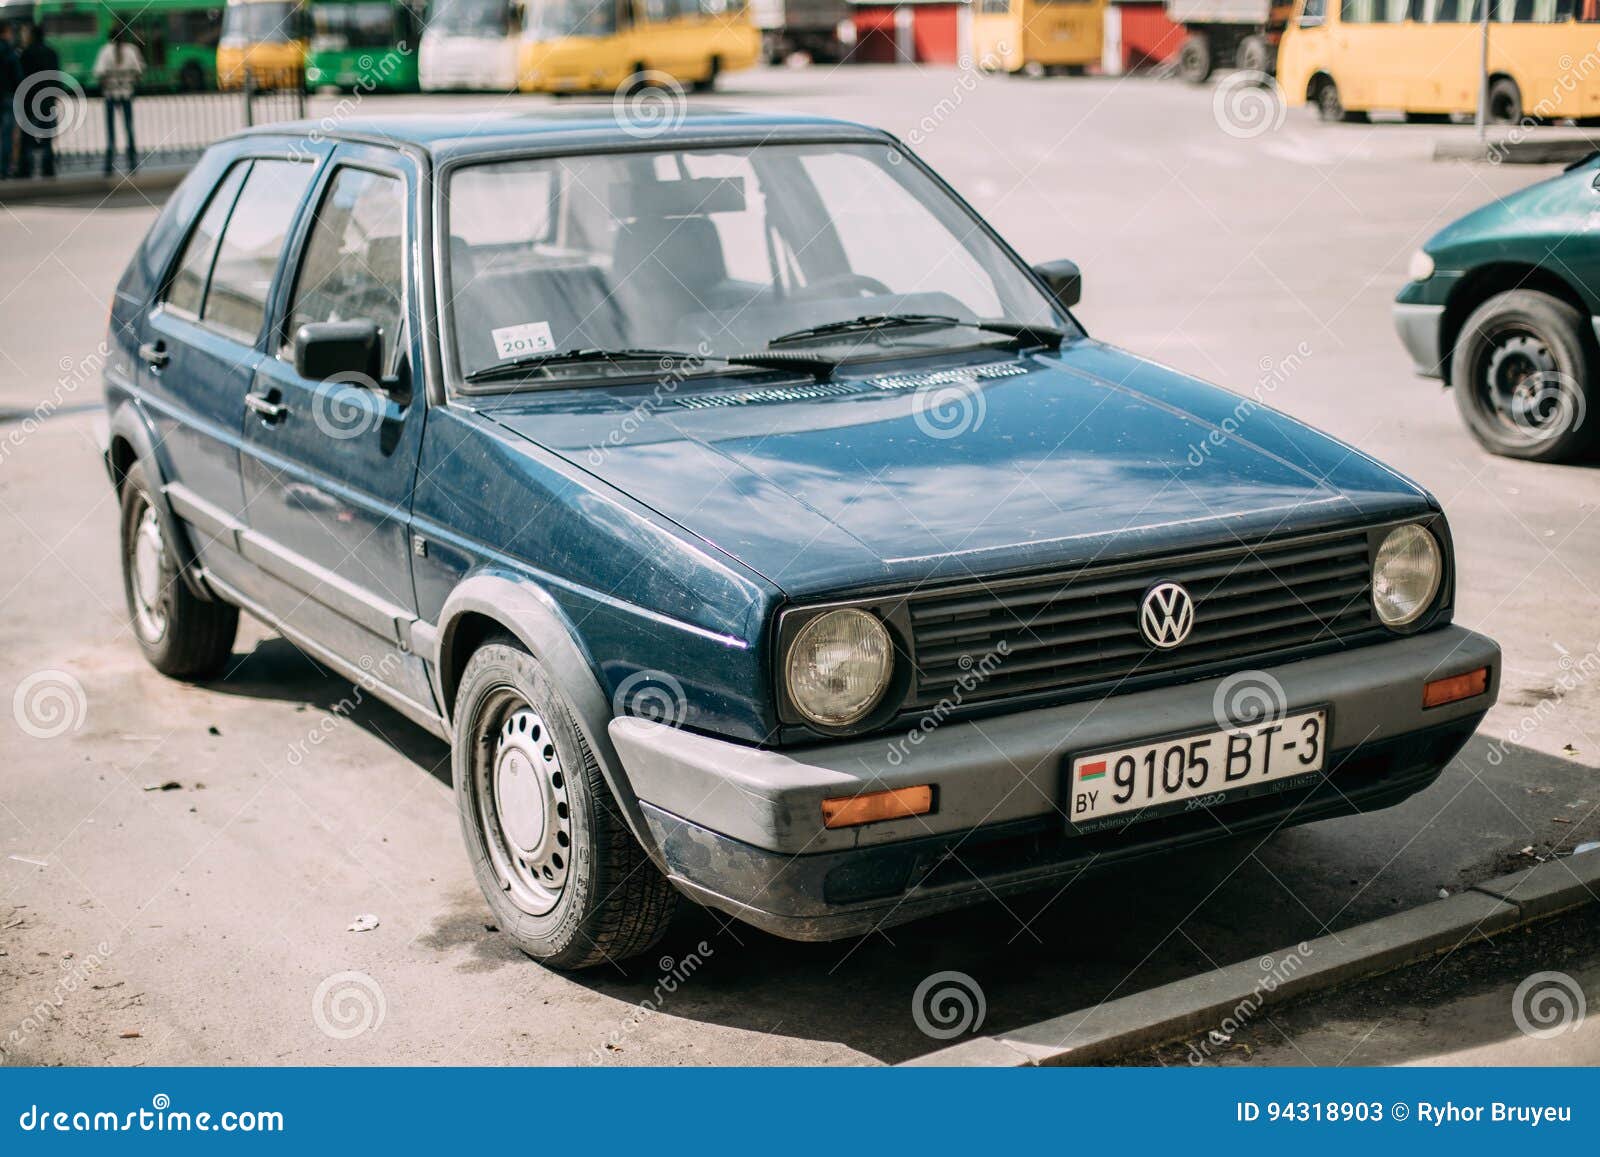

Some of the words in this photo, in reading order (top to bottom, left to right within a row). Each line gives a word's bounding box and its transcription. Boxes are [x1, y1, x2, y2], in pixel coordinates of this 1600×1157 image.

[503, 336, 548, 352] 2015
[1141, 583, 1193, 648] VW
[1113, 740, 1212, 804] 9105
[1225, 718, 1320, 782] BT-3
[1076, 790, 1099, 813] BY
